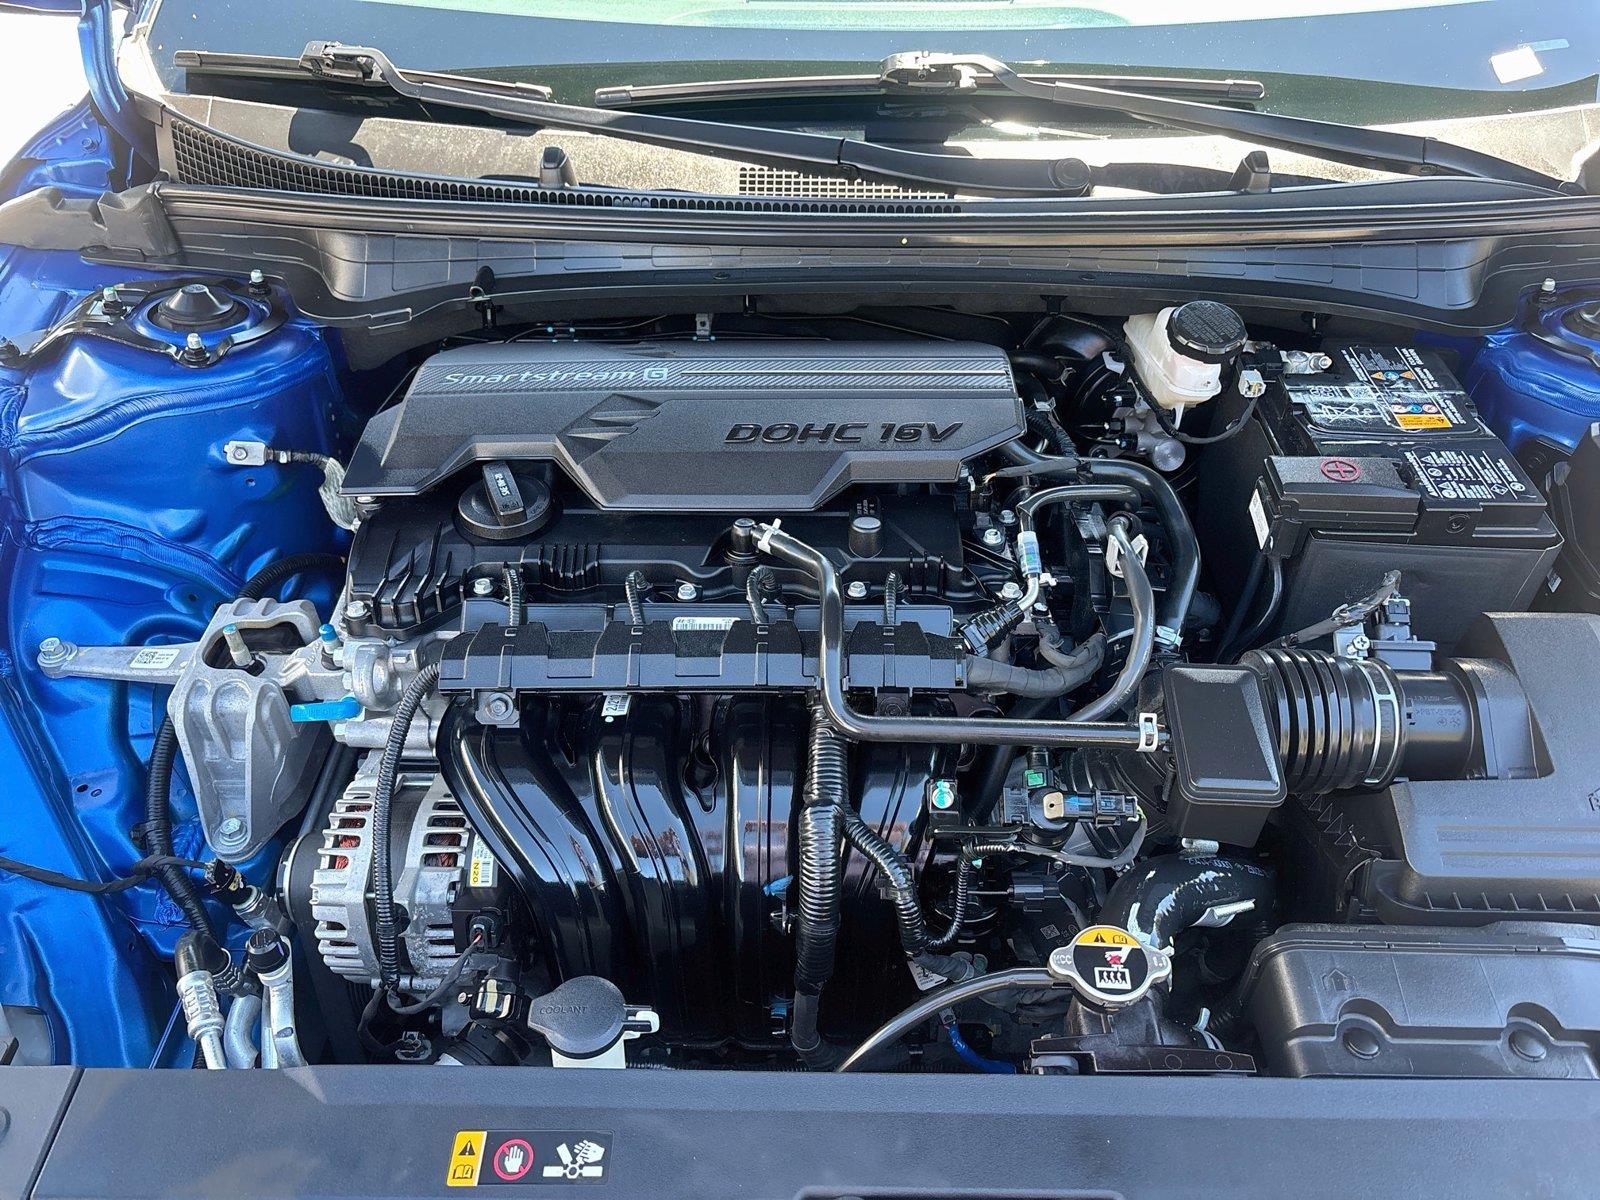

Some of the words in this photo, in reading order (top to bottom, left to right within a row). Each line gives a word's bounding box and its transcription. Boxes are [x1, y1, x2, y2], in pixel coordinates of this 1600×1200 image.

[444, 369, 637, 384] Smartstream
[724, 422, 869, 443] DOHC
[880, 422, 963, 443] 16V
[472, 862, 480, 883] N20
[539, 1005, 588, 1015] COOLANT
